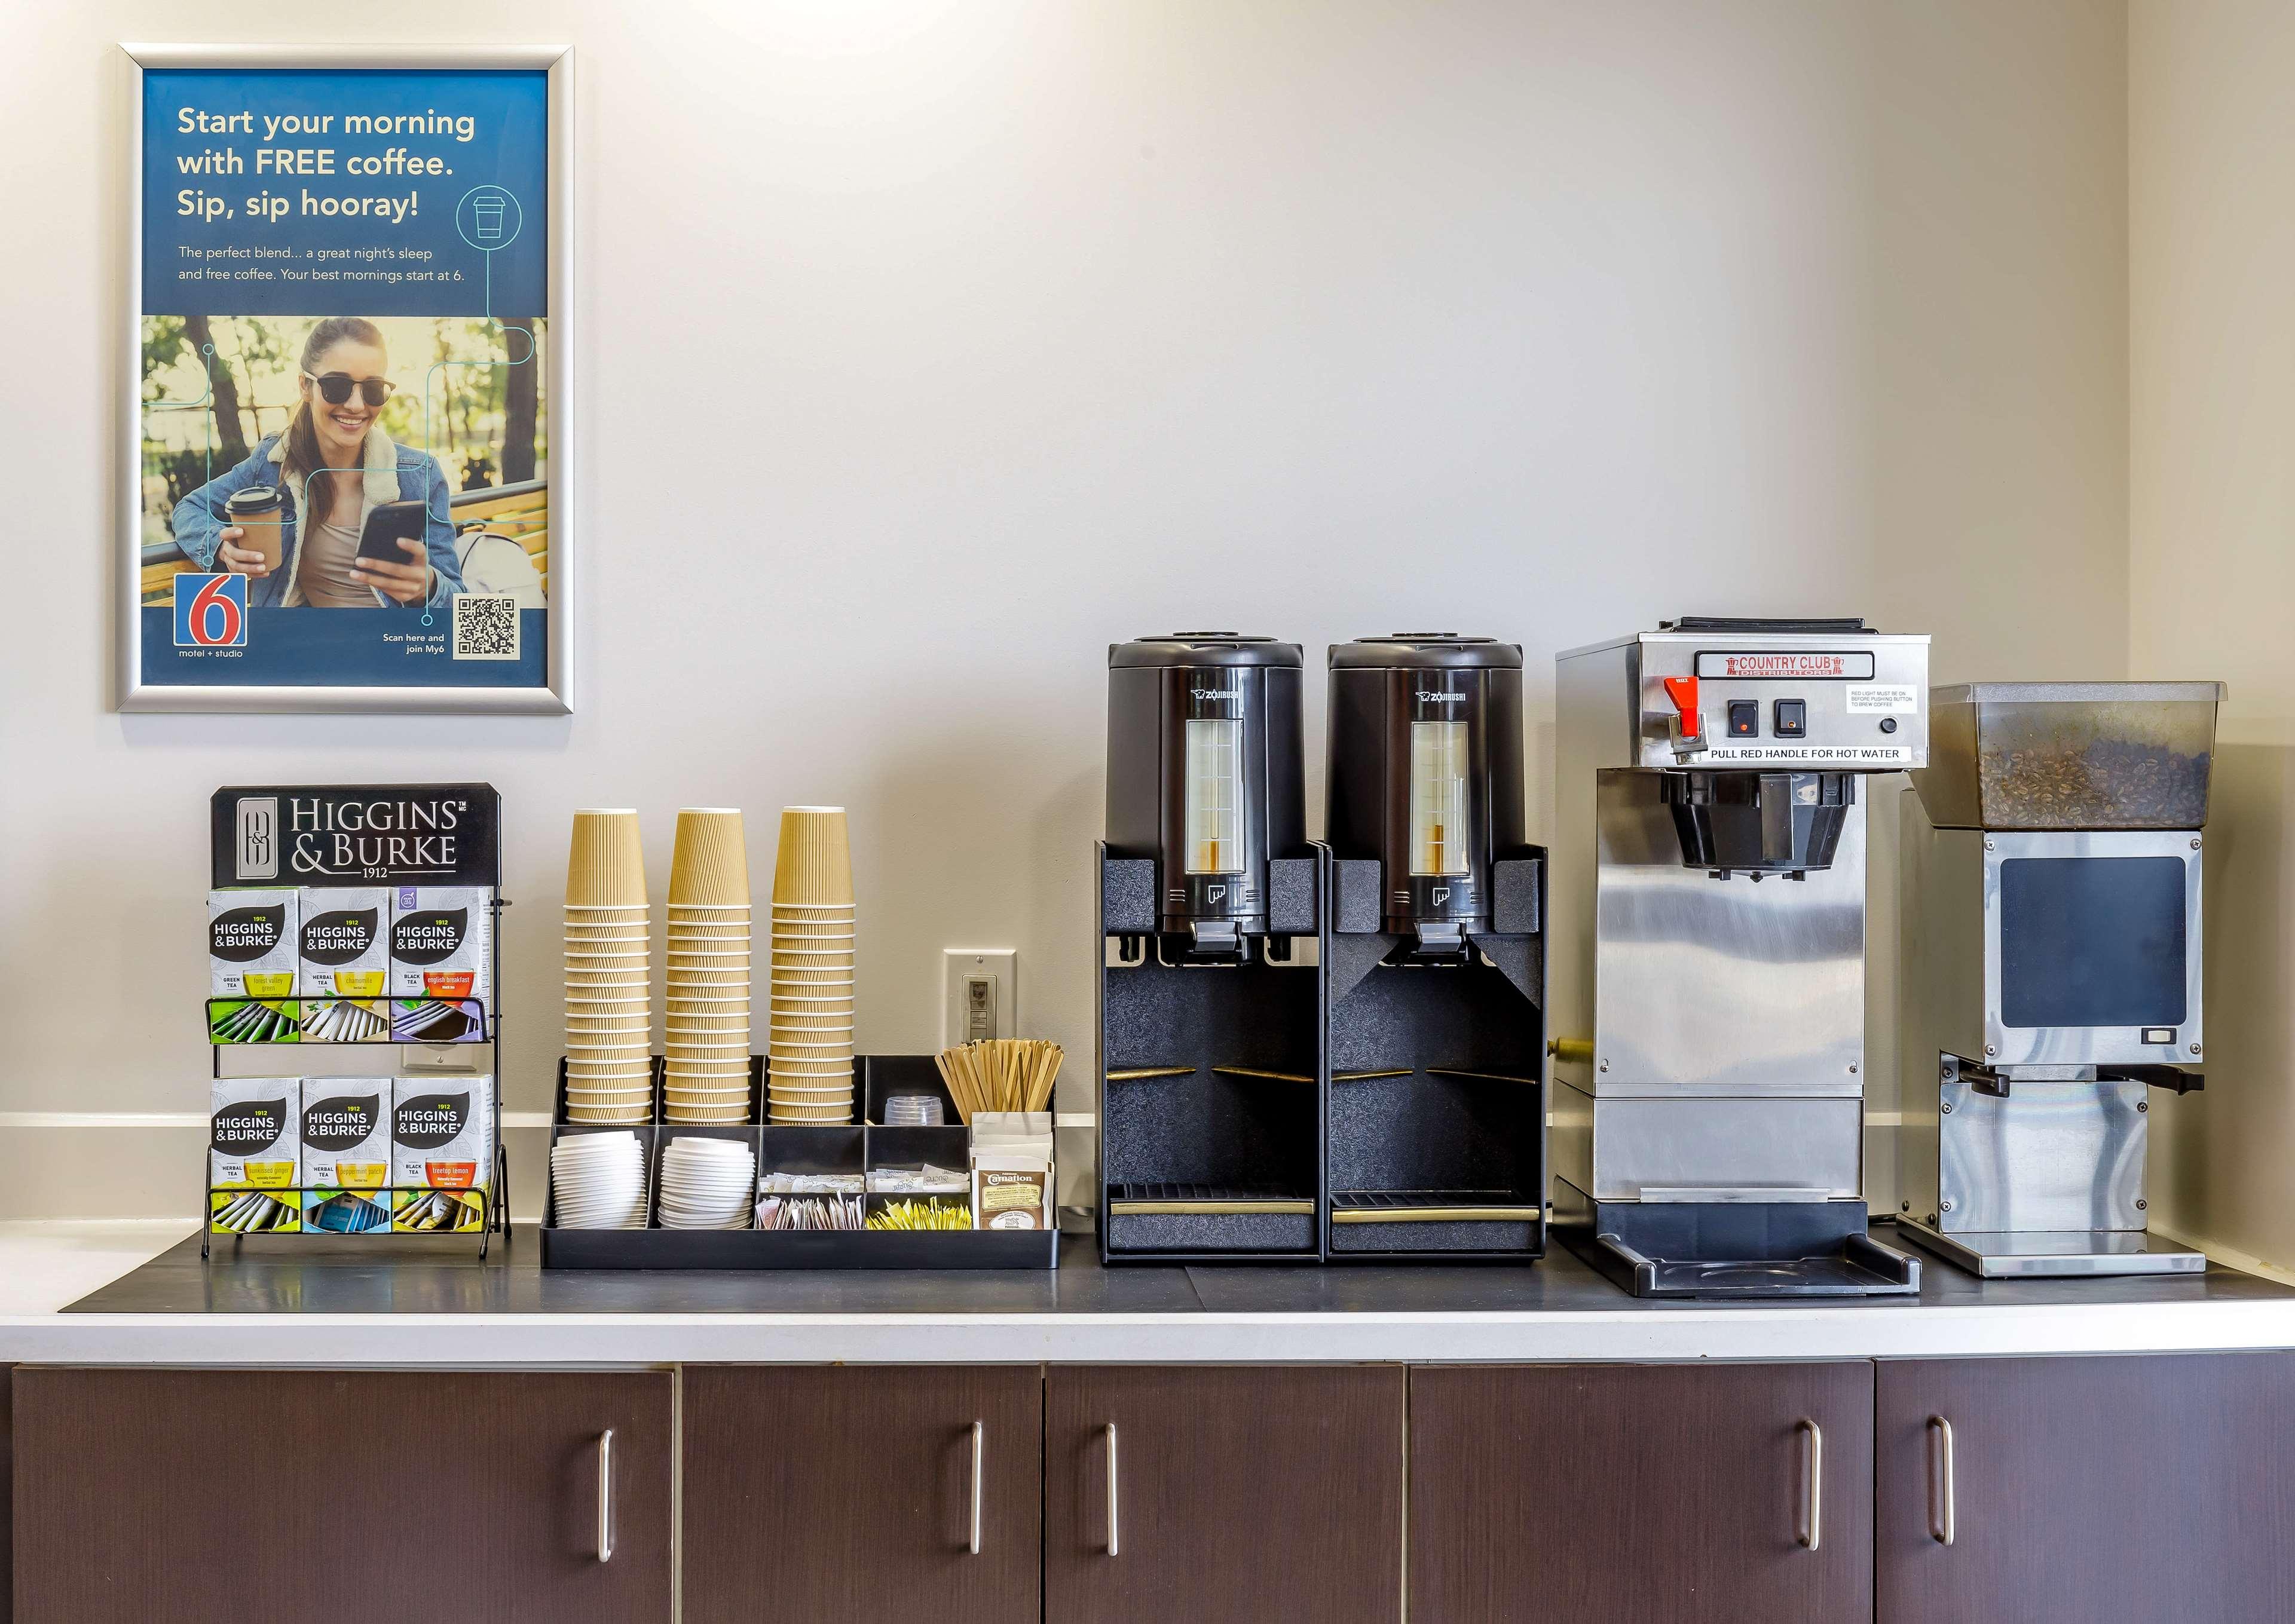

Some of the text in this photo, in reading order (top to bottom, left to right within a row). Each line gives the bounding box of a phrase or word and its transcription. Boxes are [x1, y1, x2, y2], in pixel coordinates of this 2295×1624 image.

[177, 108, 475, 142] Start your morning
[177, 148, 453, 175] with FREE coffee.
[178, 189, 418, 223] Sip, sip hooray!
[179, 247, 202, 258] The
[206, 246, 250, 262] perfect
[255, 246, 302, 259] blend...
[307, 250, 313, 259] a
[317, 249, 351, 262] great
[399, 248, 432, 263] sleep
[179, 268, 464, 284] and free coffee. Your best mornings start at 6.
[189, 575, 240, 644] 6
[383, 633, 444, 642] Scan here and
[406, 645, 445, 654] join My6
[1740, 656, 1831, 670] COUNTRY CLUB
[1431, 691, 1466, 703] ZOJIRUSHI
[1711, 749, 1899, 759] PULL RED HANDLE FOR HOT WATER
[290, 798, 457, 831] HIGGINS
[333, 834, 456, 866] BURKE
[363, 868, 388, 878] 1912
[215, 923, 273, 934] HIGGINS
[307, 927, 365, 937] HIGGINS
[397, 927, 455, 937] HIGGINS
[308, 1113, 366, 1124] HIGGINS
[399, 1110, 457, 1122] HIGGINS
[216, 1117, 274, 1129] HIGGINS
[987, 1173, 1033, 1185] Carnation
[892, 1181, 914, 1191] Sugar
